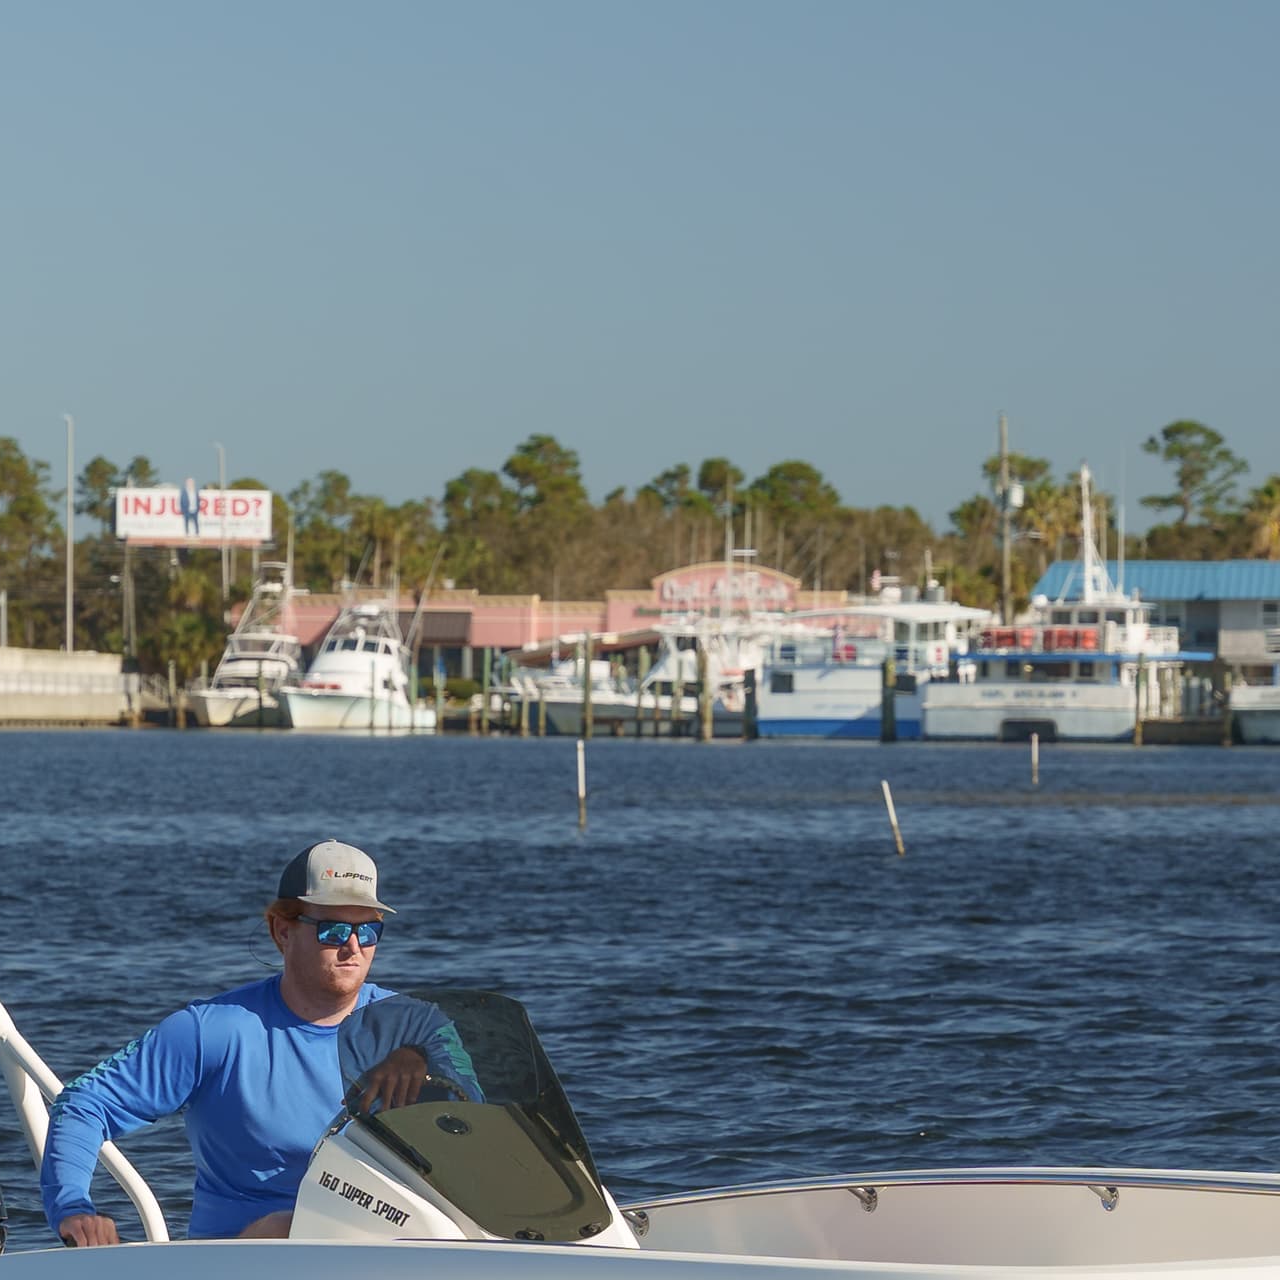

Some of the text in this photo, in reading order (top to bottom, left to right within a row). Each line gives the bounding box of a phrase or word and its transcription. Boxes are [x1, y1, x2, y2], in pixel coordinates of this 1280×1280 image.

[123, 495, 263, 517] INJURED?
[318, 1170, 412, 1228] 160 SUPER SPORT
